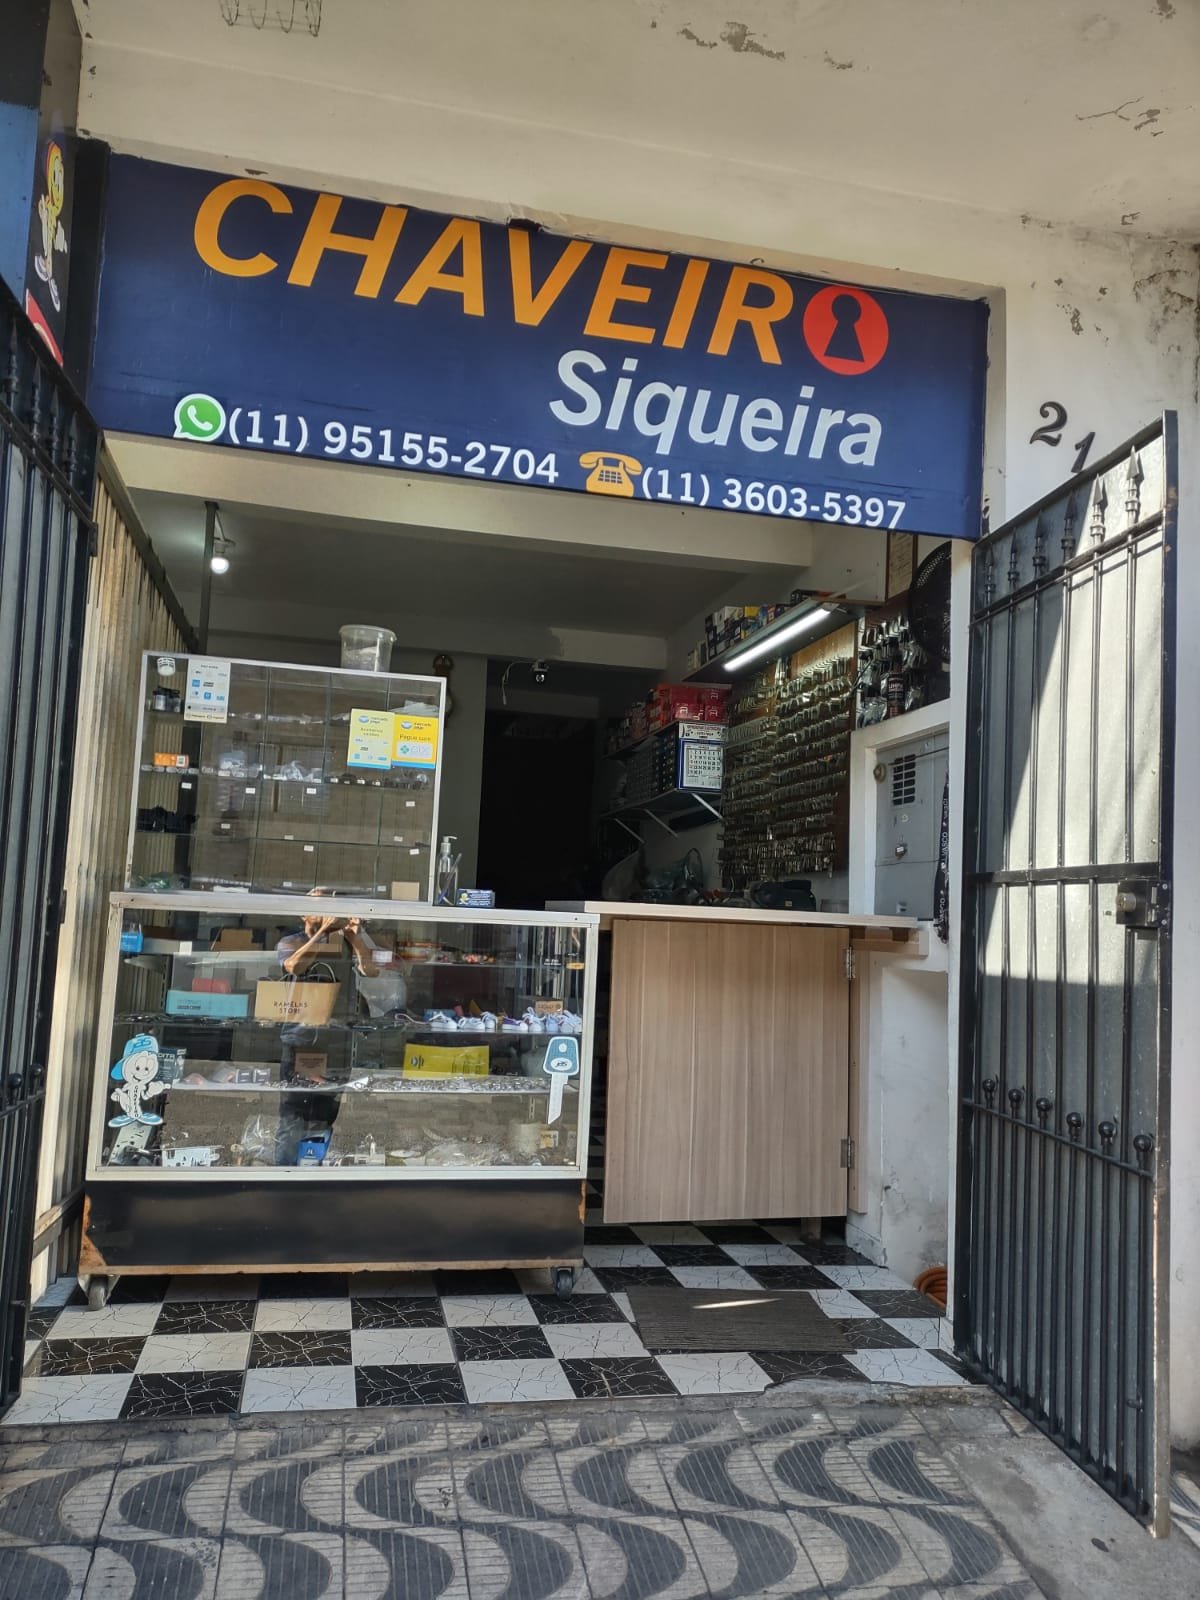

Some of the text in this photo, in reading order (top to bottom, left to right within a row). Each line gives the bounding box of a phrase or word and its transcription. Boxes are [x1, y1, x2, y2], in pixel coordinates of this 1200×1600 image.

[228, 407, 560, 485] (11) 95155-2704
[549, 349, 882, 467] Siqueira
[642, 466, 907, 530] (11) 3603-5397
